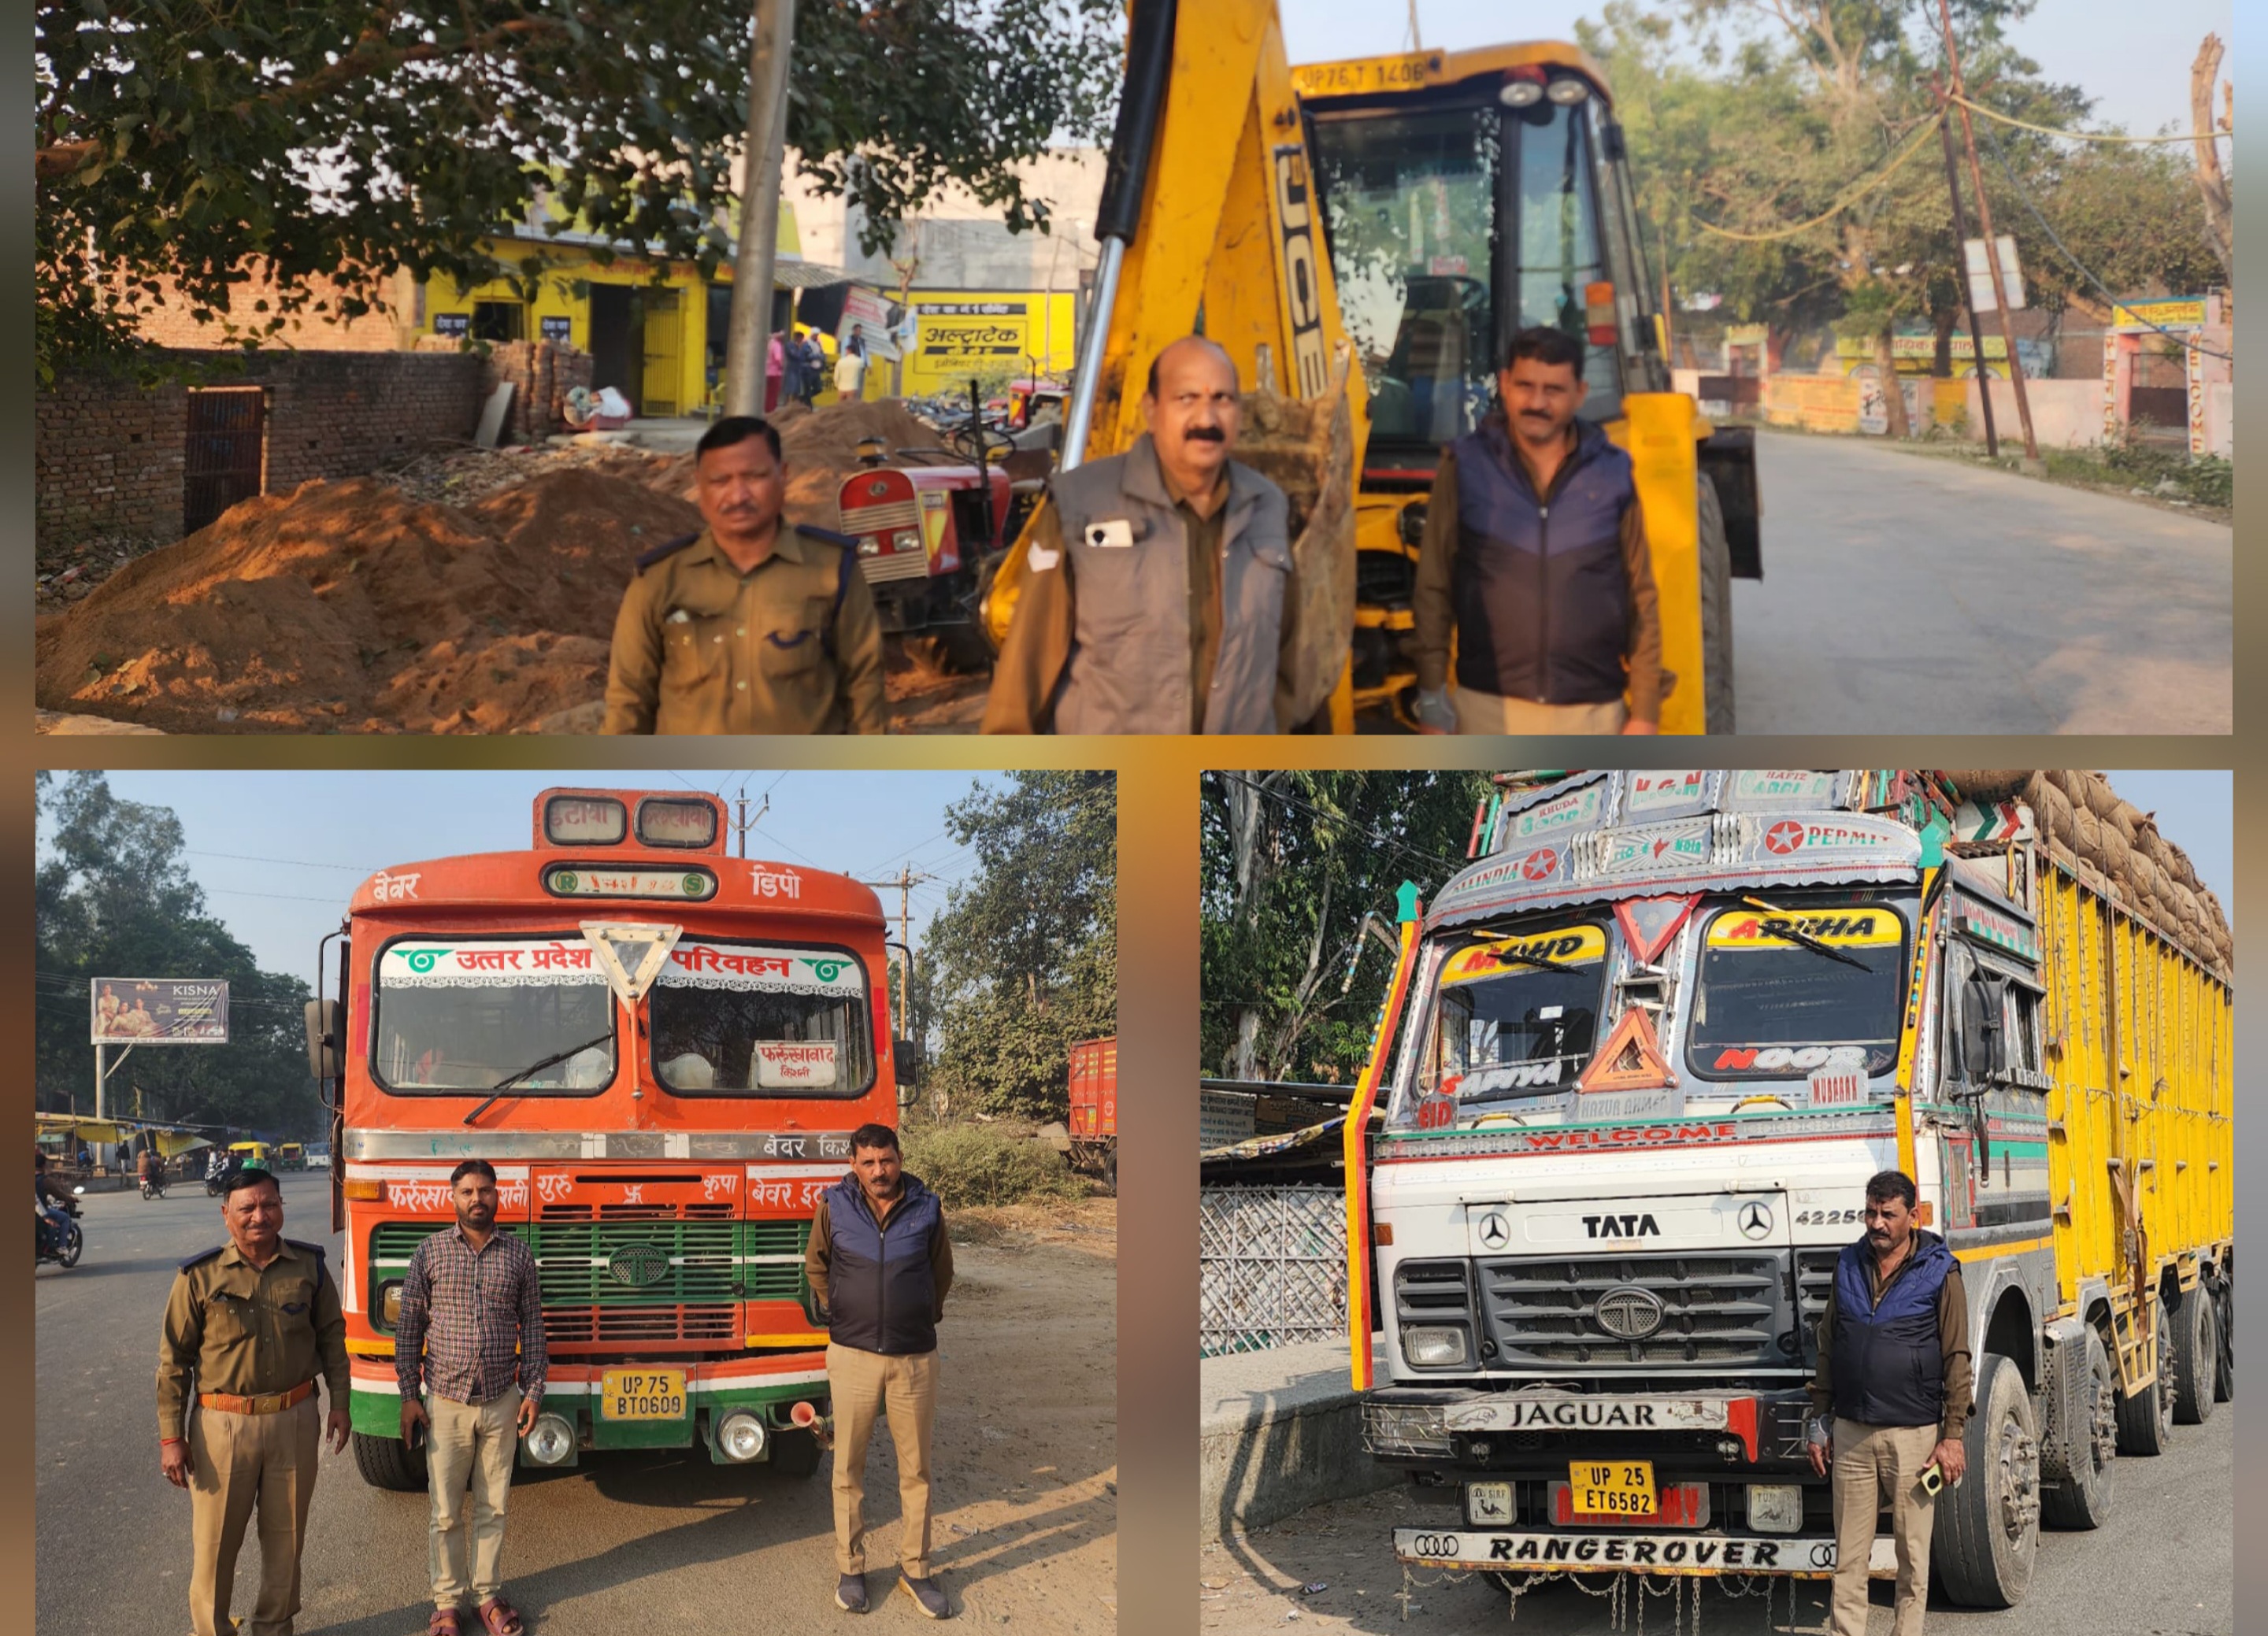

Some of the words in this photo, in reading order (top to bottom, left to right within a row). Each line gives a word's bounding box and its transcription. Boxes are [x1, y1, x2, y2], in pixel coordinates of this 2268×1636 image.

[924, 325, 1019, 345] अल्ट्राटेक
[2188, 332, 2203, 450] WELCOME
[1766, 770, 1807, 781] HAFIZ
[1539, 796, 1579, 818] KHUDA
[373, 872, 422, 902] बेवर
[749, 865, 803, 899] डिपो
[455, 948, 524, 972] उत्तर
[531, 942, 592, 972] प्रदेश
[671, 945, 792, 979] परिवहन
[172, 985, 217, 996] KISNA
[1713, 1046, 1866, 1070] NOOR
[1418, 1101, 1453, 1129] EID
[1526, 1123, 1736, 1149] WELCOME
[536, 1173, 573, 1203] गुरु
[702, 1173, 739, 1201] कृपा
[1582, 1213, 1661, 1238] TATA
[623, 1376, 643, 1394] UP
[648, 1375, 669, 1394] 75
[1512, 1403, 1657, 1427] JAGUAR
[1591, 1467, 1611, 1486] UP
[1624, 1468, 1645, 1486] 25
[1587, 1490, 1651, 1513] ET6582
